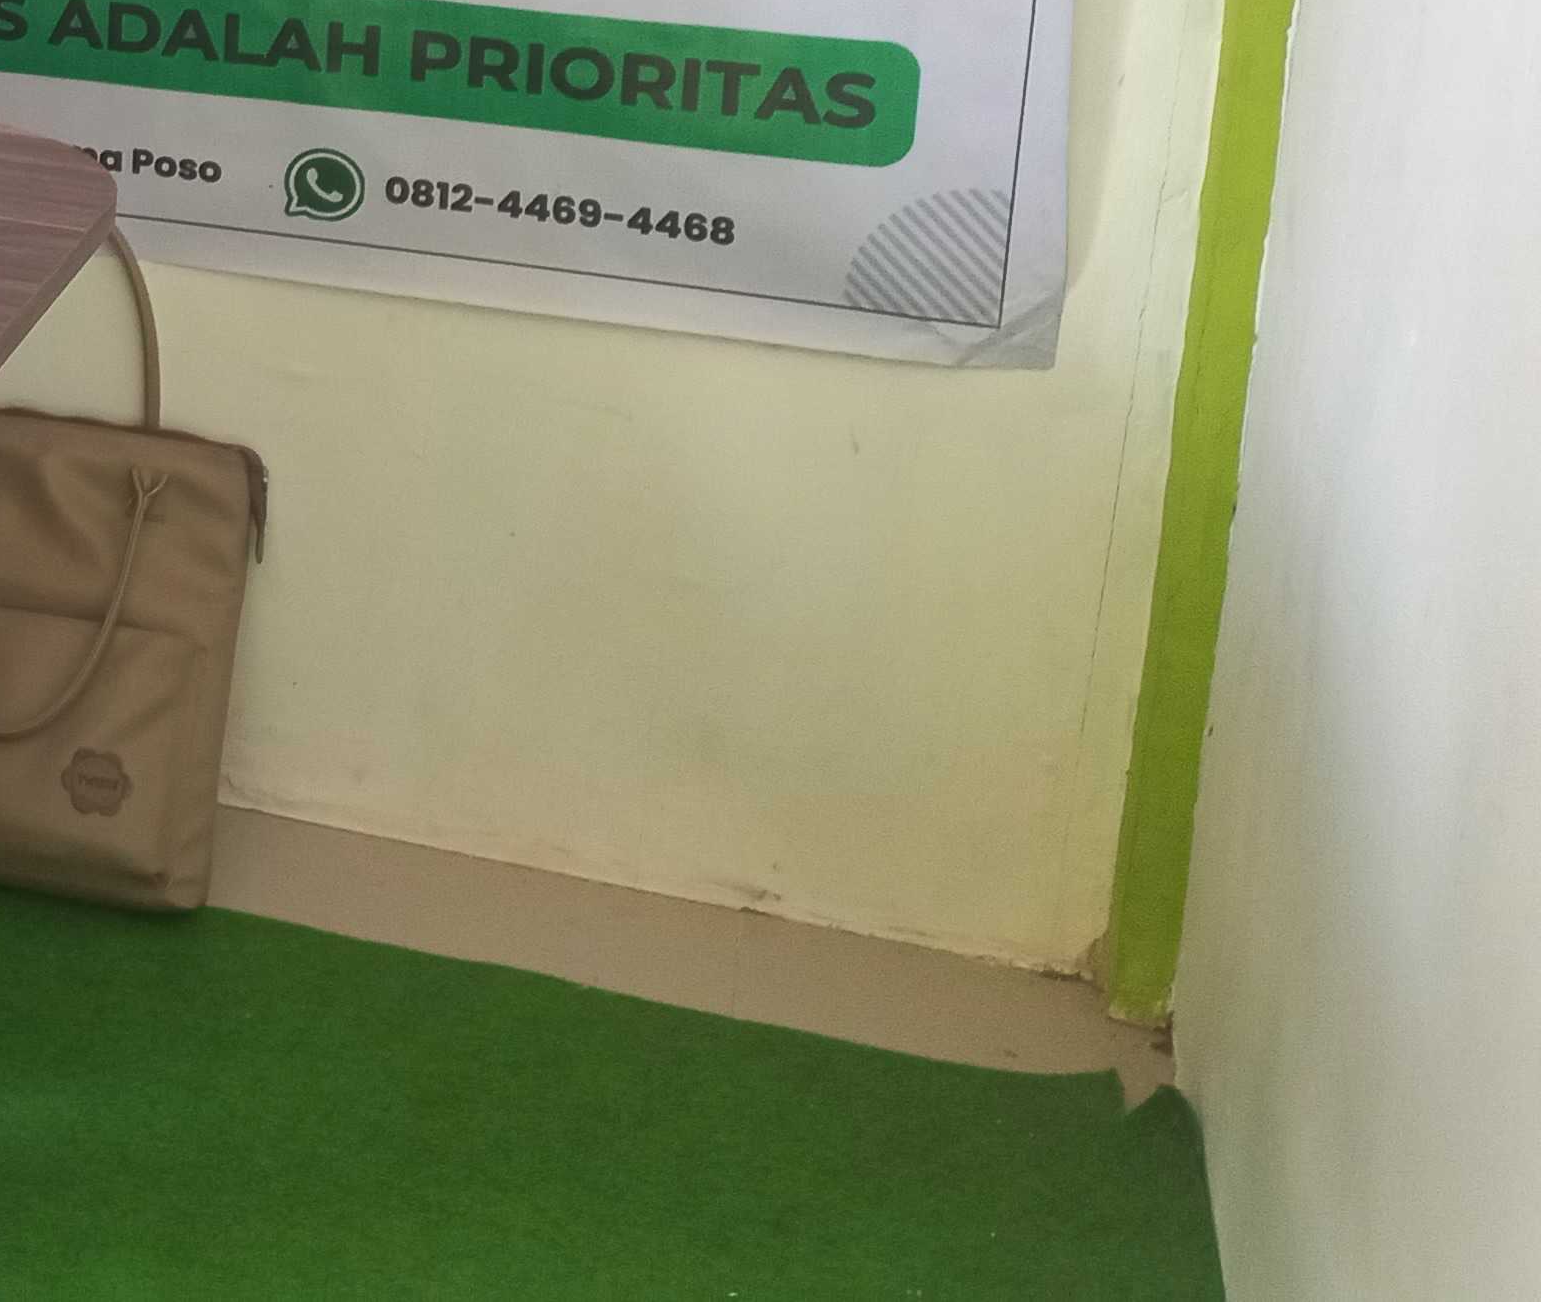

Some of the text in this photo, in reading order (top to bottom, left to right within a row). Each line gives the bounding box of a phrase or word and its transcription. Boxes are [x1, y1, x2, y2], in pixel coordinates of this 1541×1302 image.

[410, 31, 877, 130] PRIORITAS
[132, 148, 222, 183] Poso
[384, 175, 736, 247] 0812-4469-4468
